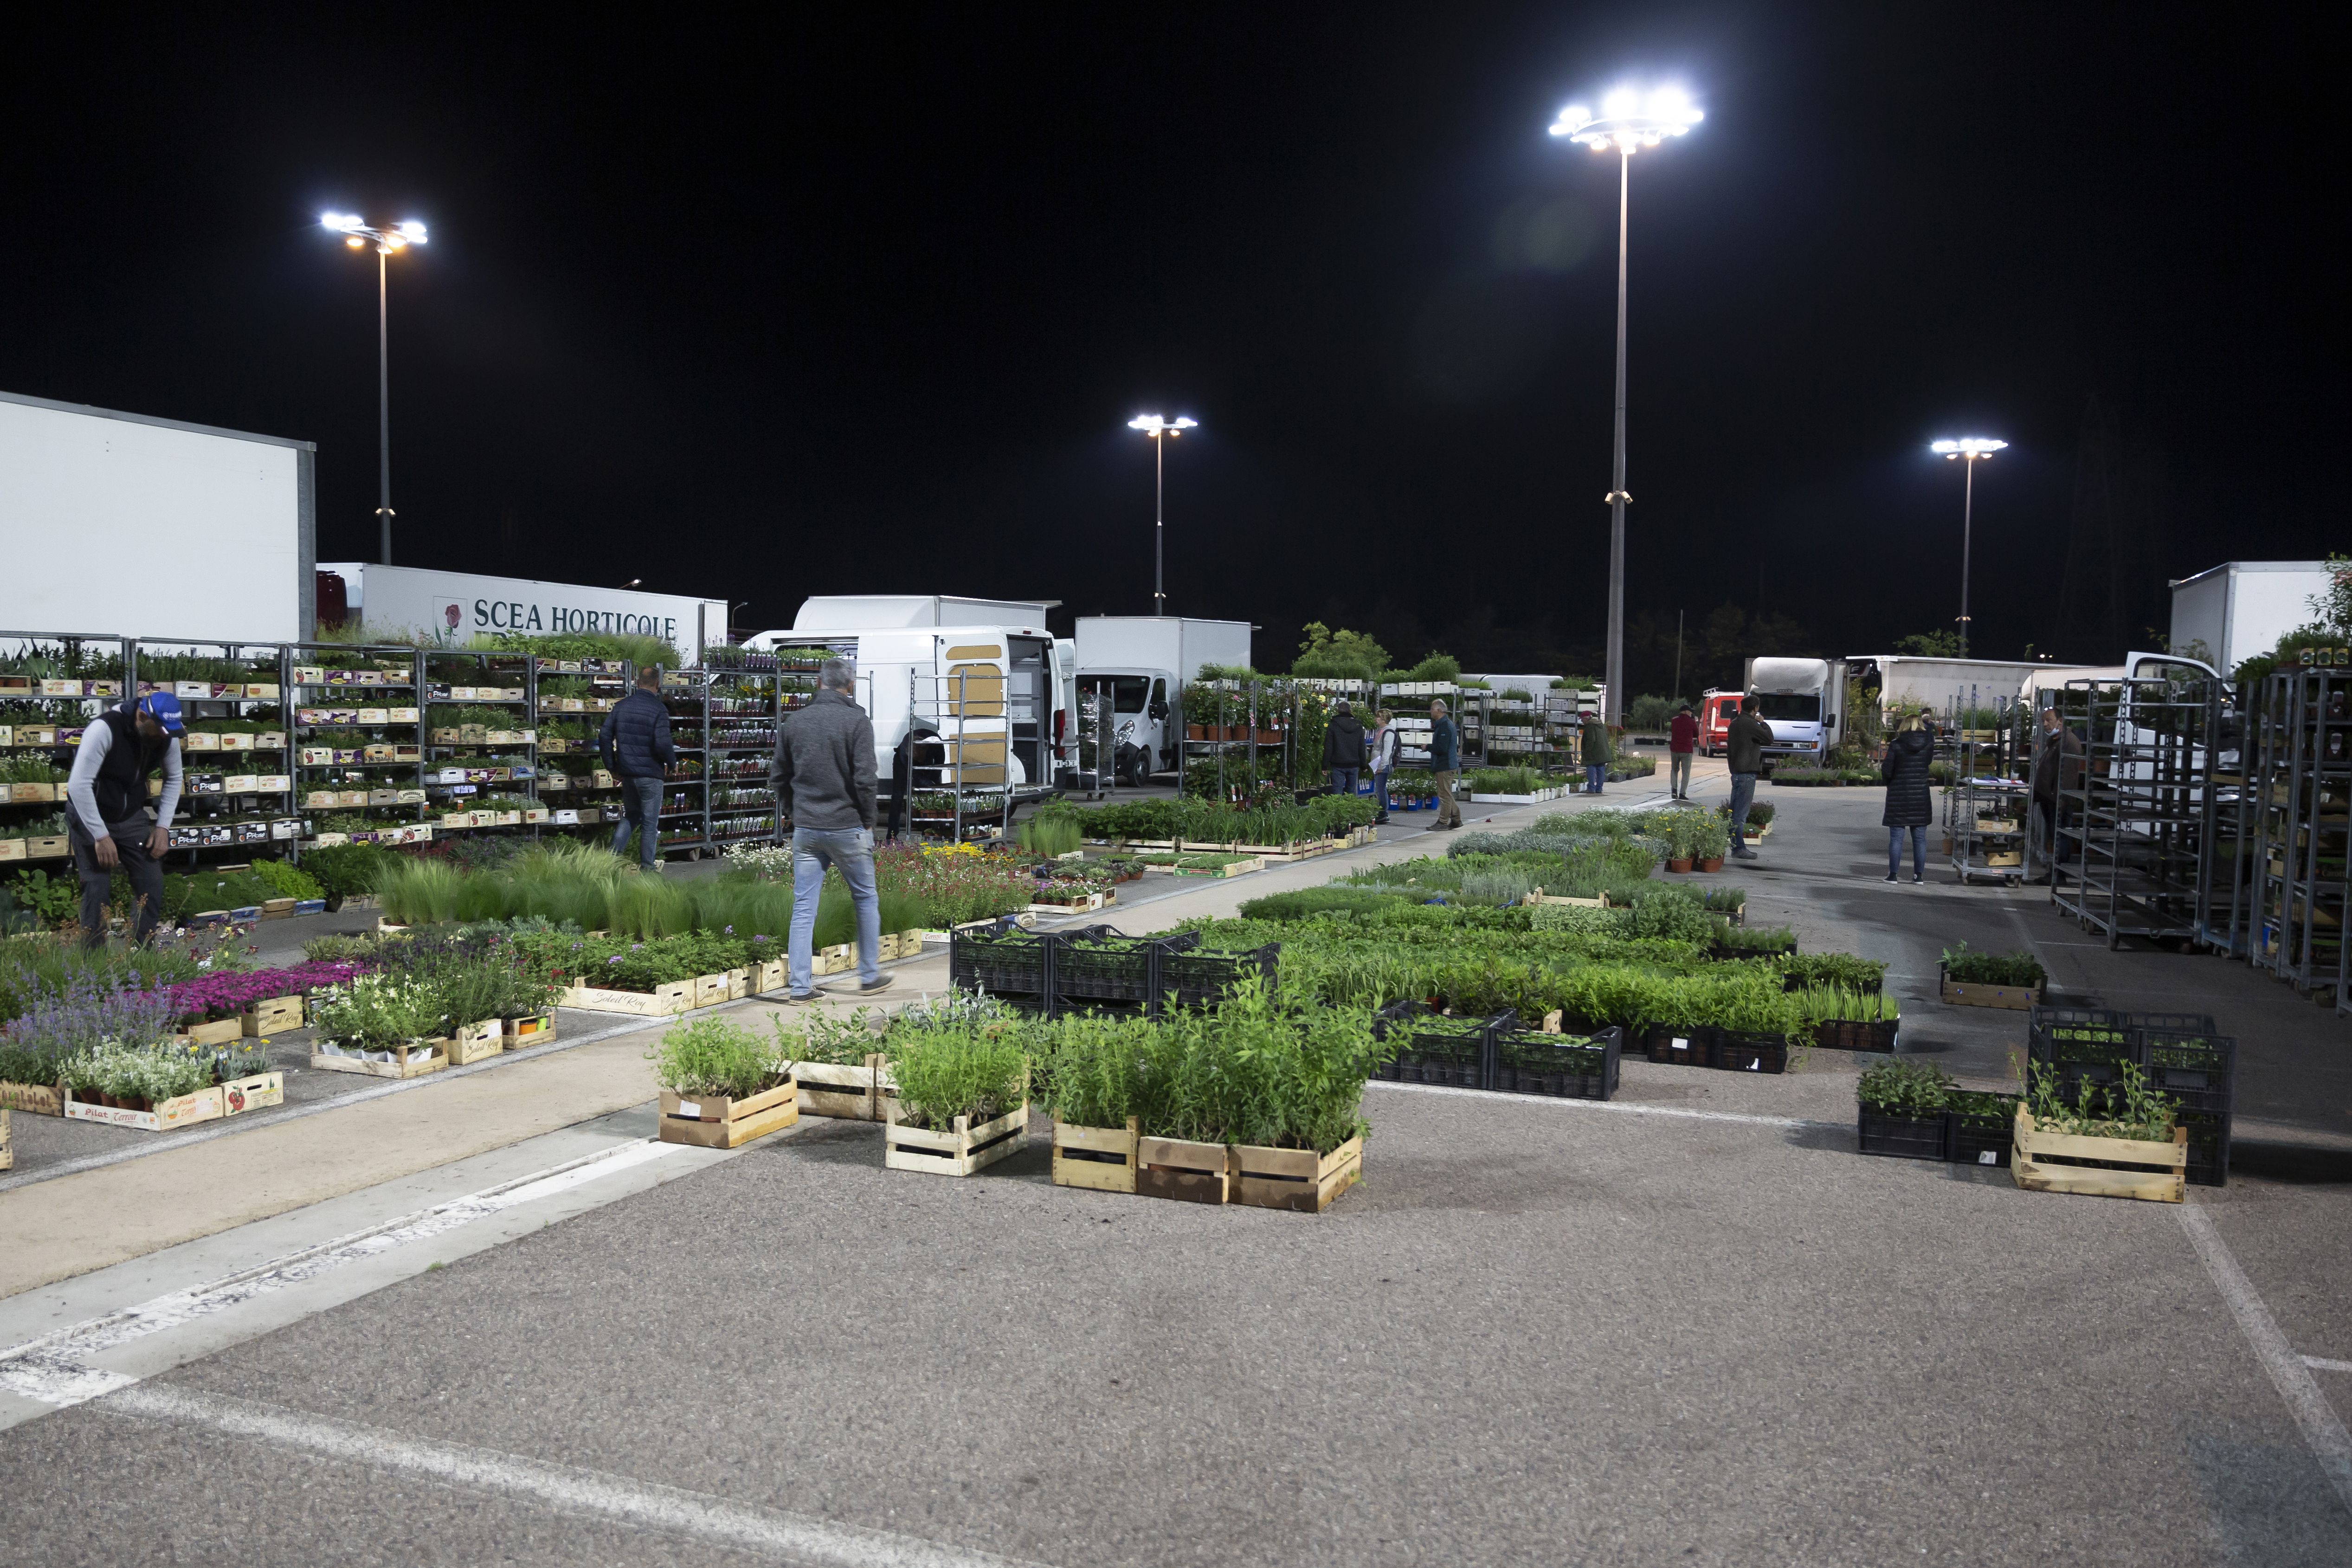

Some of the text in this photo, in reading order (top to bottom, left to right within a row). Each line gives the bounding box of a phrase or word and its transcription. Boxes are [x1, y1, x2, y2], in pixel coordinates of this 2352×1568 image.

[475, 599, 676, 640] SCEA HORTICOLE
[592, 992, 646, 1011] Soleil Roy
[664, 994, 693, 1010] Soleil Roy
[699, 987, 726, 1002] Soleil Roy
[261, 1012, 299, 1029] Soleil Roy
[465, 1038, 500, 1058] Soleil Roy
[178, 1097, 197, 1107] Pilat
[85, 1108, 138, 1121] Pilat Terroir
